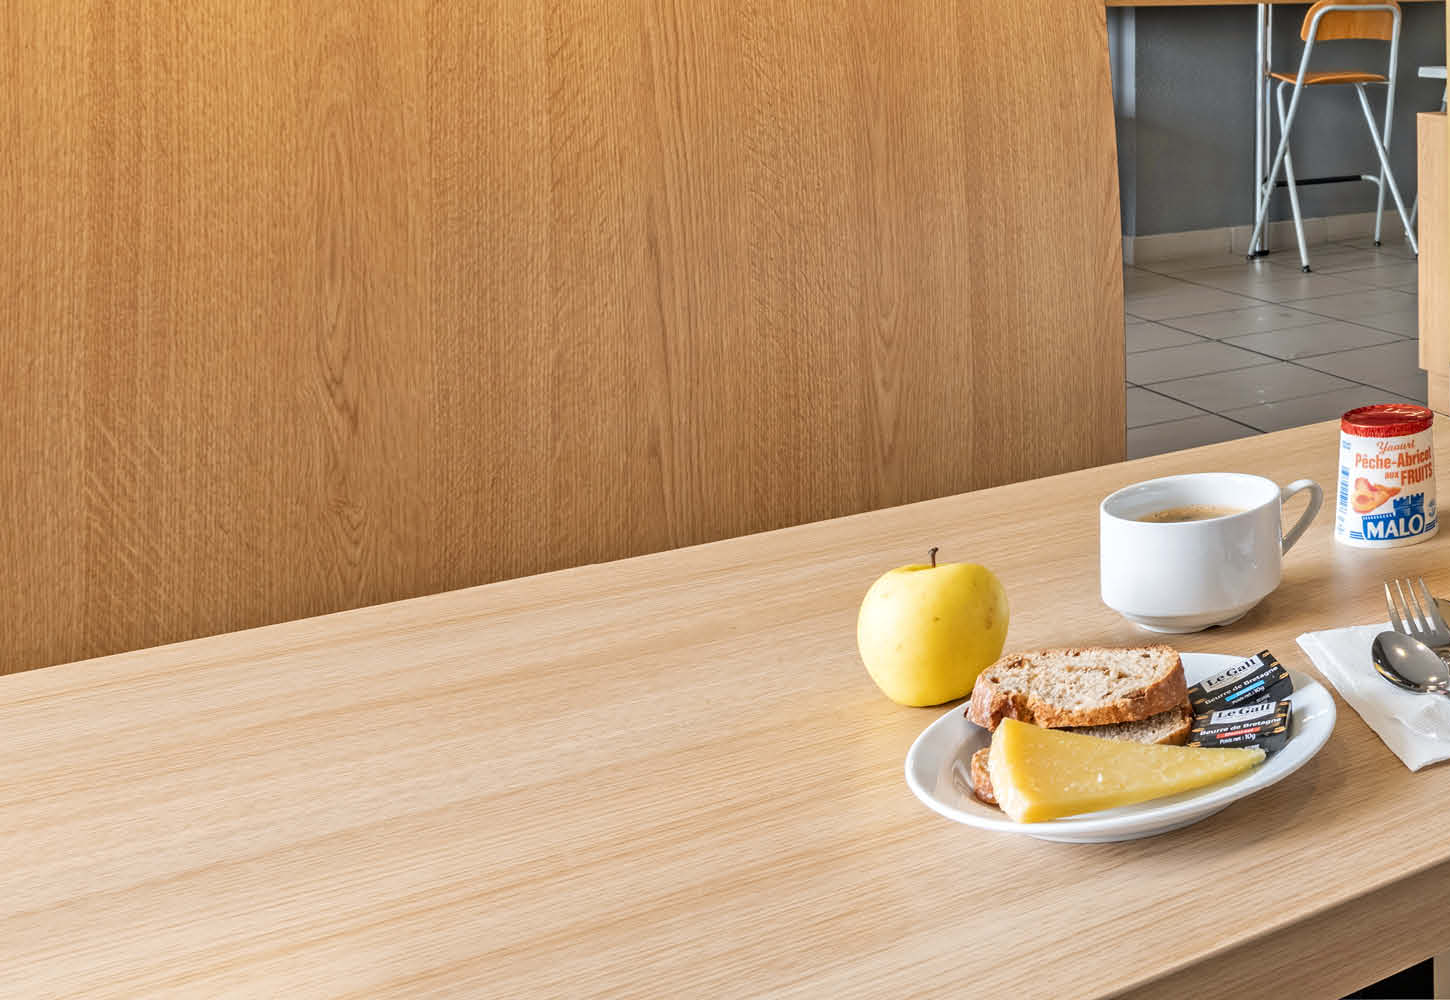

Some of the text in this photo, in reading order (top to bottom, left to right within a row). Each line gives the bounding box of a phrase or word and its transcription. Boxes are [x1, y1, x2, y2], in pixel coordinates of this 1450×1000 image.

[1355, 447, 1432, 469] Pêche-Abricot
[1400, 462, 1433, 485] FRUITS
[1366, 514, 1424, 539] MALO
[1226, 658, 1256, 677] Gall
[1204, 690, 1232, 705] Beurre
[1232, 683, 1243, 692] de
[1243, 666, 1279, 685] Bretagne
[1200, 727, 1229, 735] Beurre
[1243, 718, 1282, 728] Bretagne
